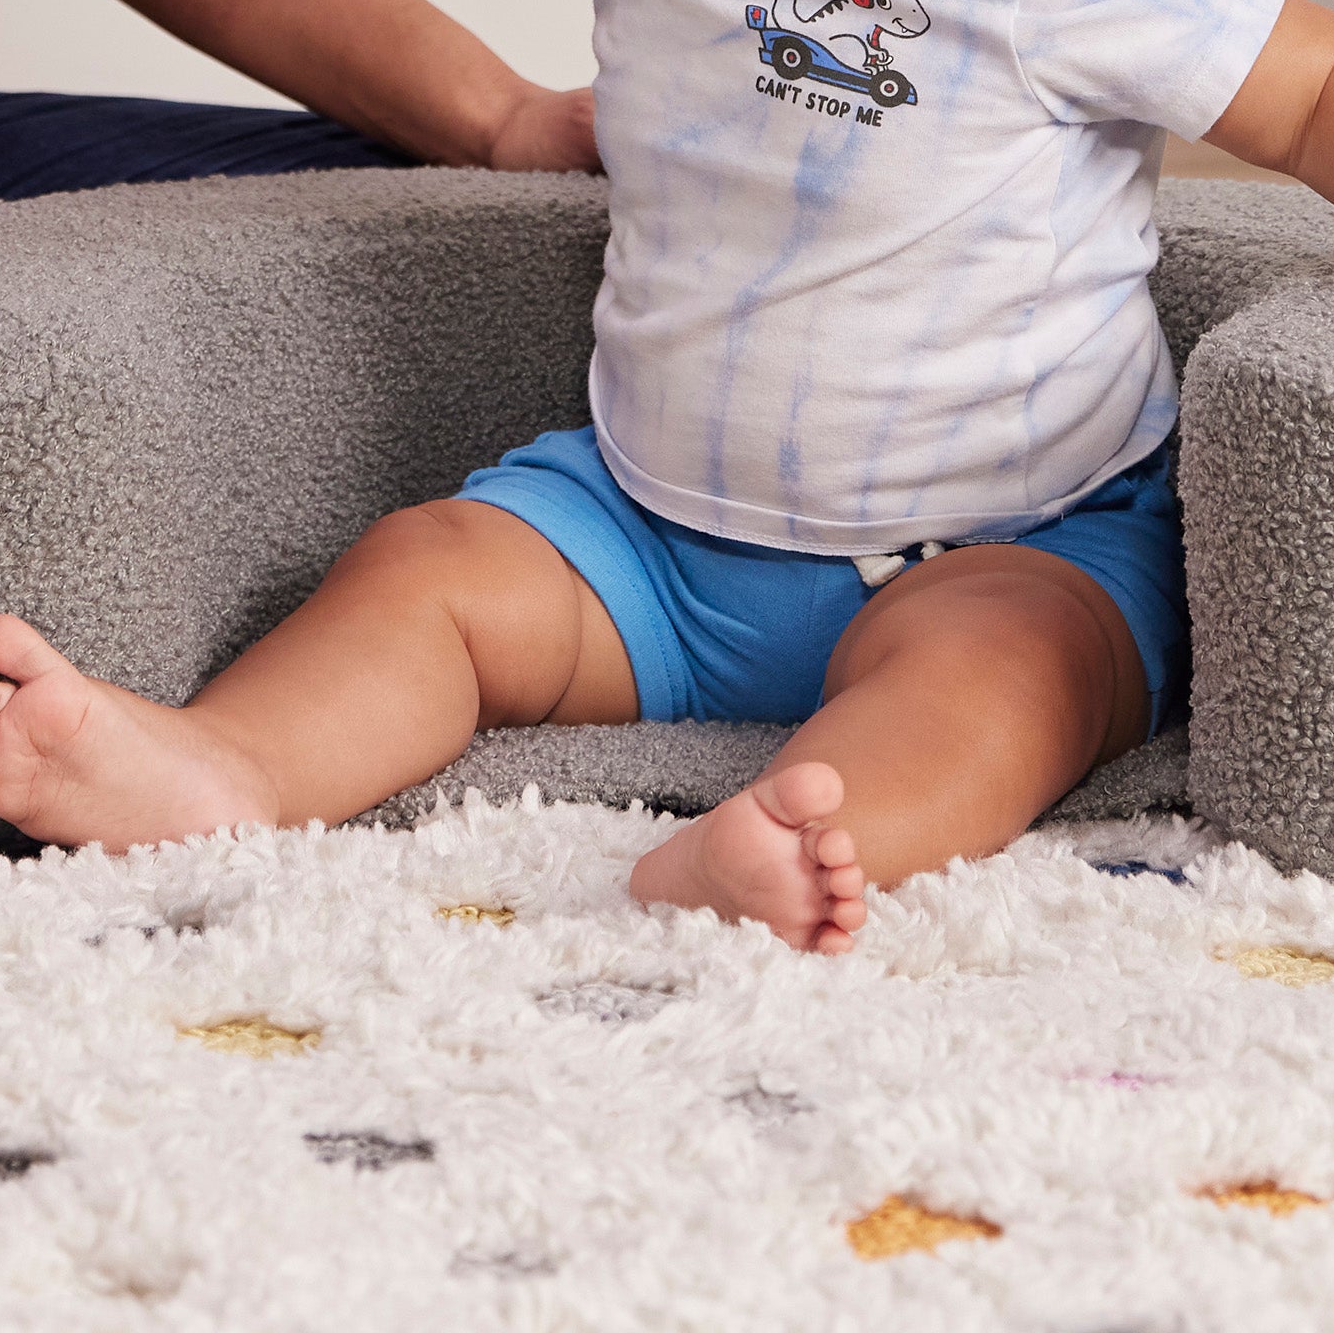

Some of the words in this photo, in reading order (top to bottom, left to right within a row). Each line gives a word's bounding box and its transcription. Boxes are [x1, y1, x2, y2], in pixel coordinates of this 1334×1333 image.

[755, 75, 802, 104] CAN'T
[805, 92, 851, 118] STOP
[855, 106, 884, 127] ME
